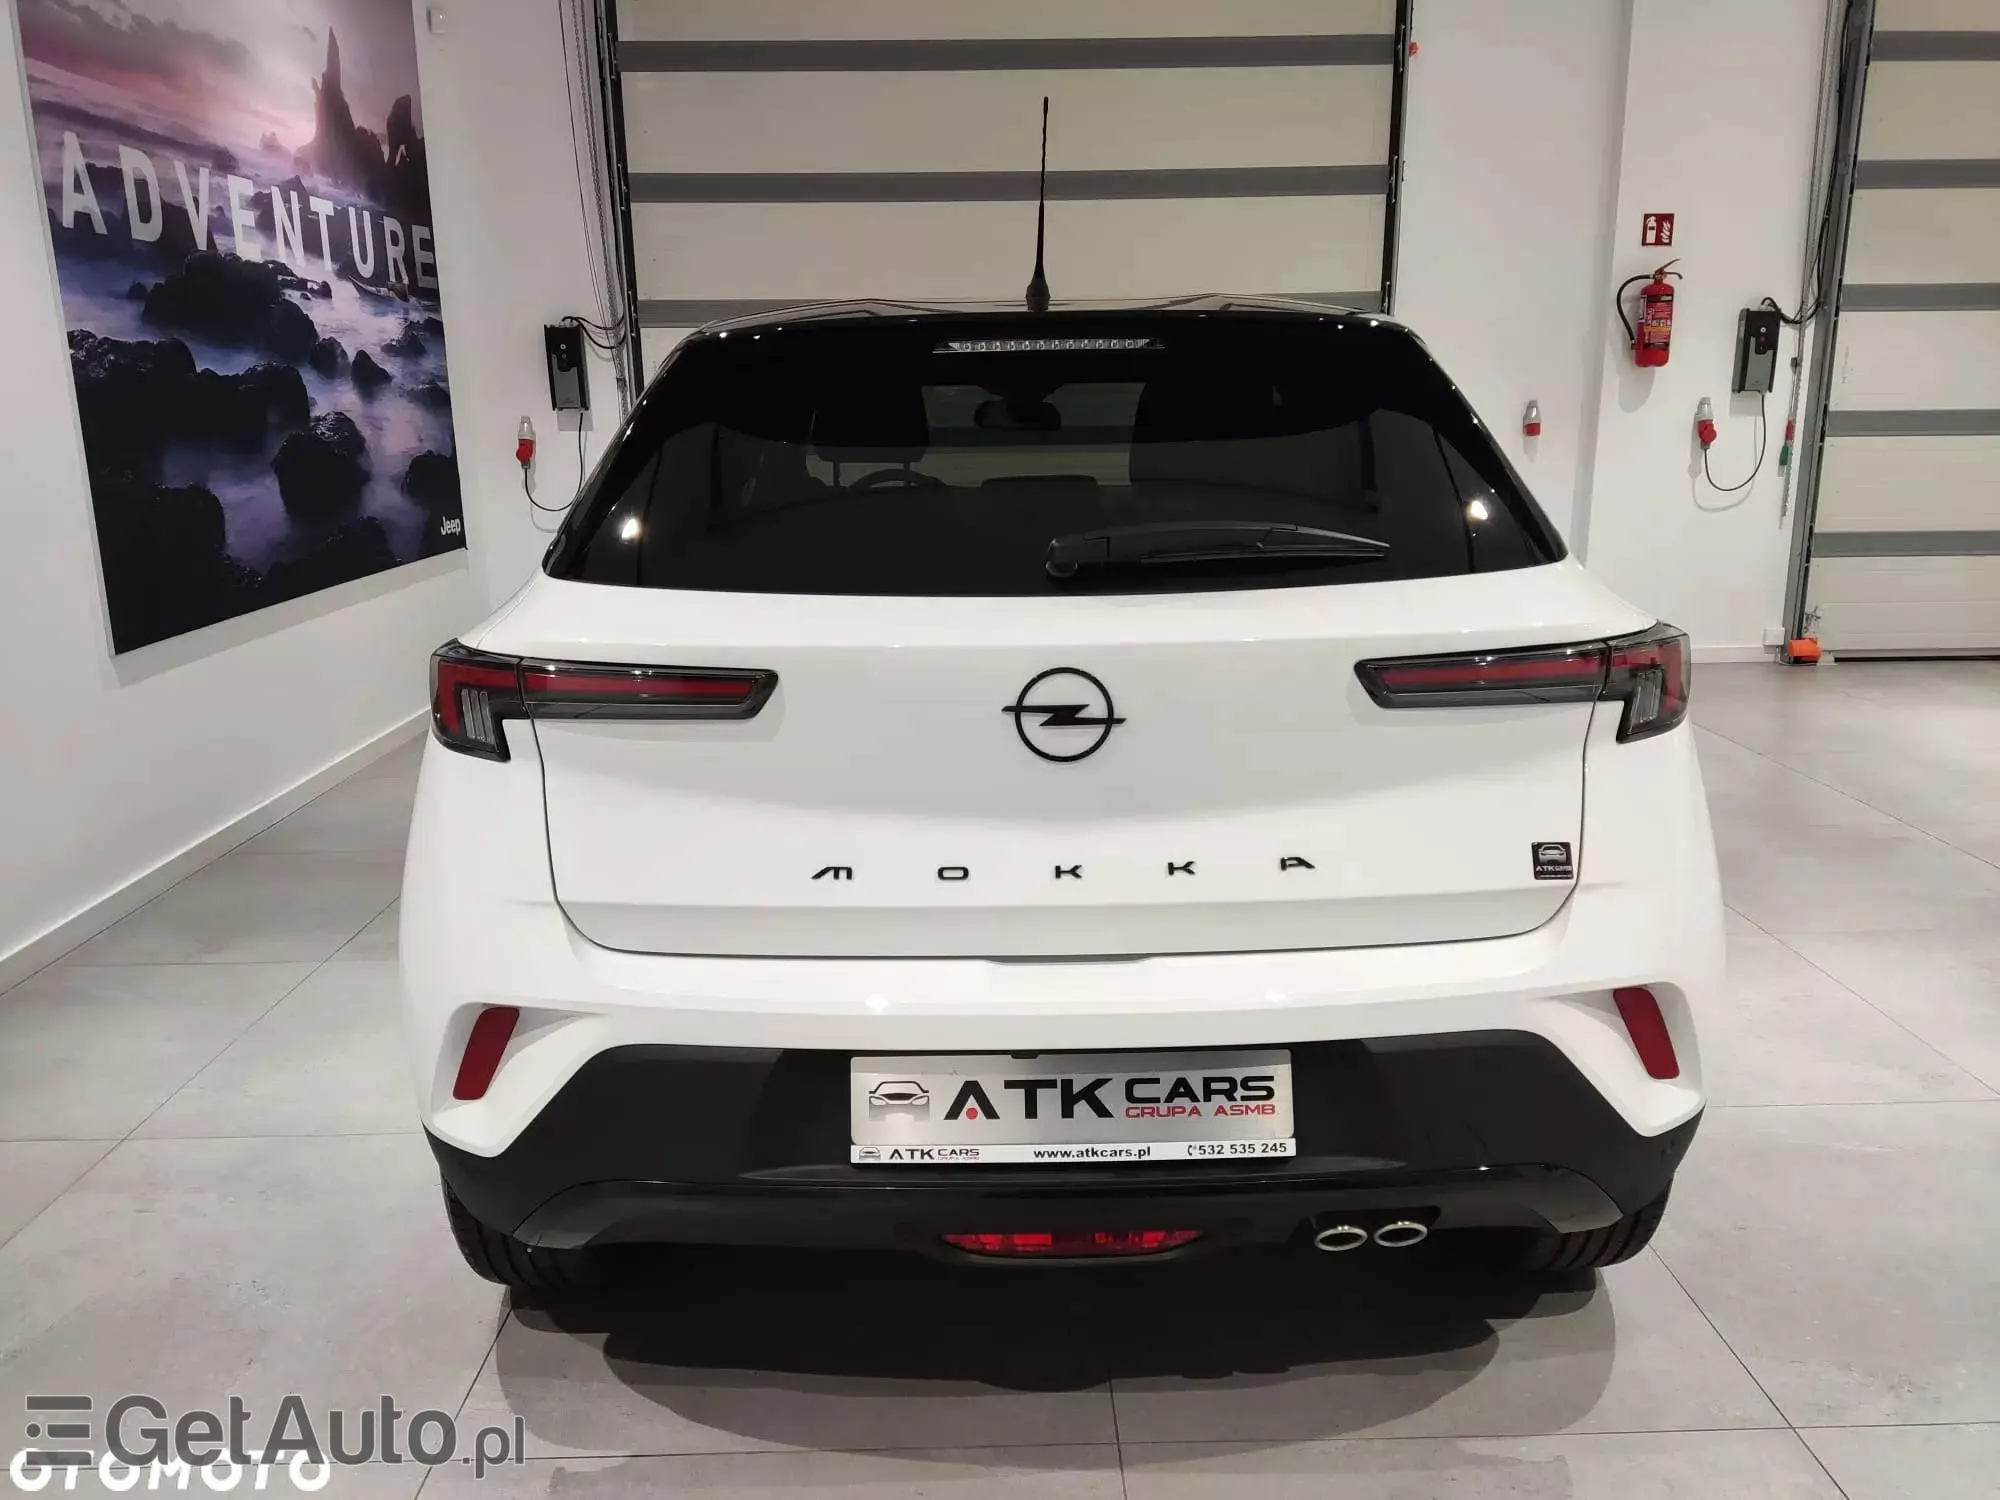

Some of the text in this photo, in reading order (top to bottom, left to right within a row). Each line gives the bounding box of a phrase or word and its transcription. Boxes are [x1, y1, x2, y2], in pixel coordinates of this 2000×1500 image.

[62, 130, 439, 289] ADVENTURE
[440, 515, 461, 537] Jeep
[811, 856, 1315, 881] MOKKA
[943, 1075, 1275, 1121] ATK CARS
[1125, 1103, 1276, 1118] GRUPA ASMB
[889, 1149, 935, 1160] ATK
[938, 1148, 979, 1156] CARS
[1033, 1146, 1151, 1160] www.atkcars.pl
[1199, 1142, 1287, 1155] 532 535 245
